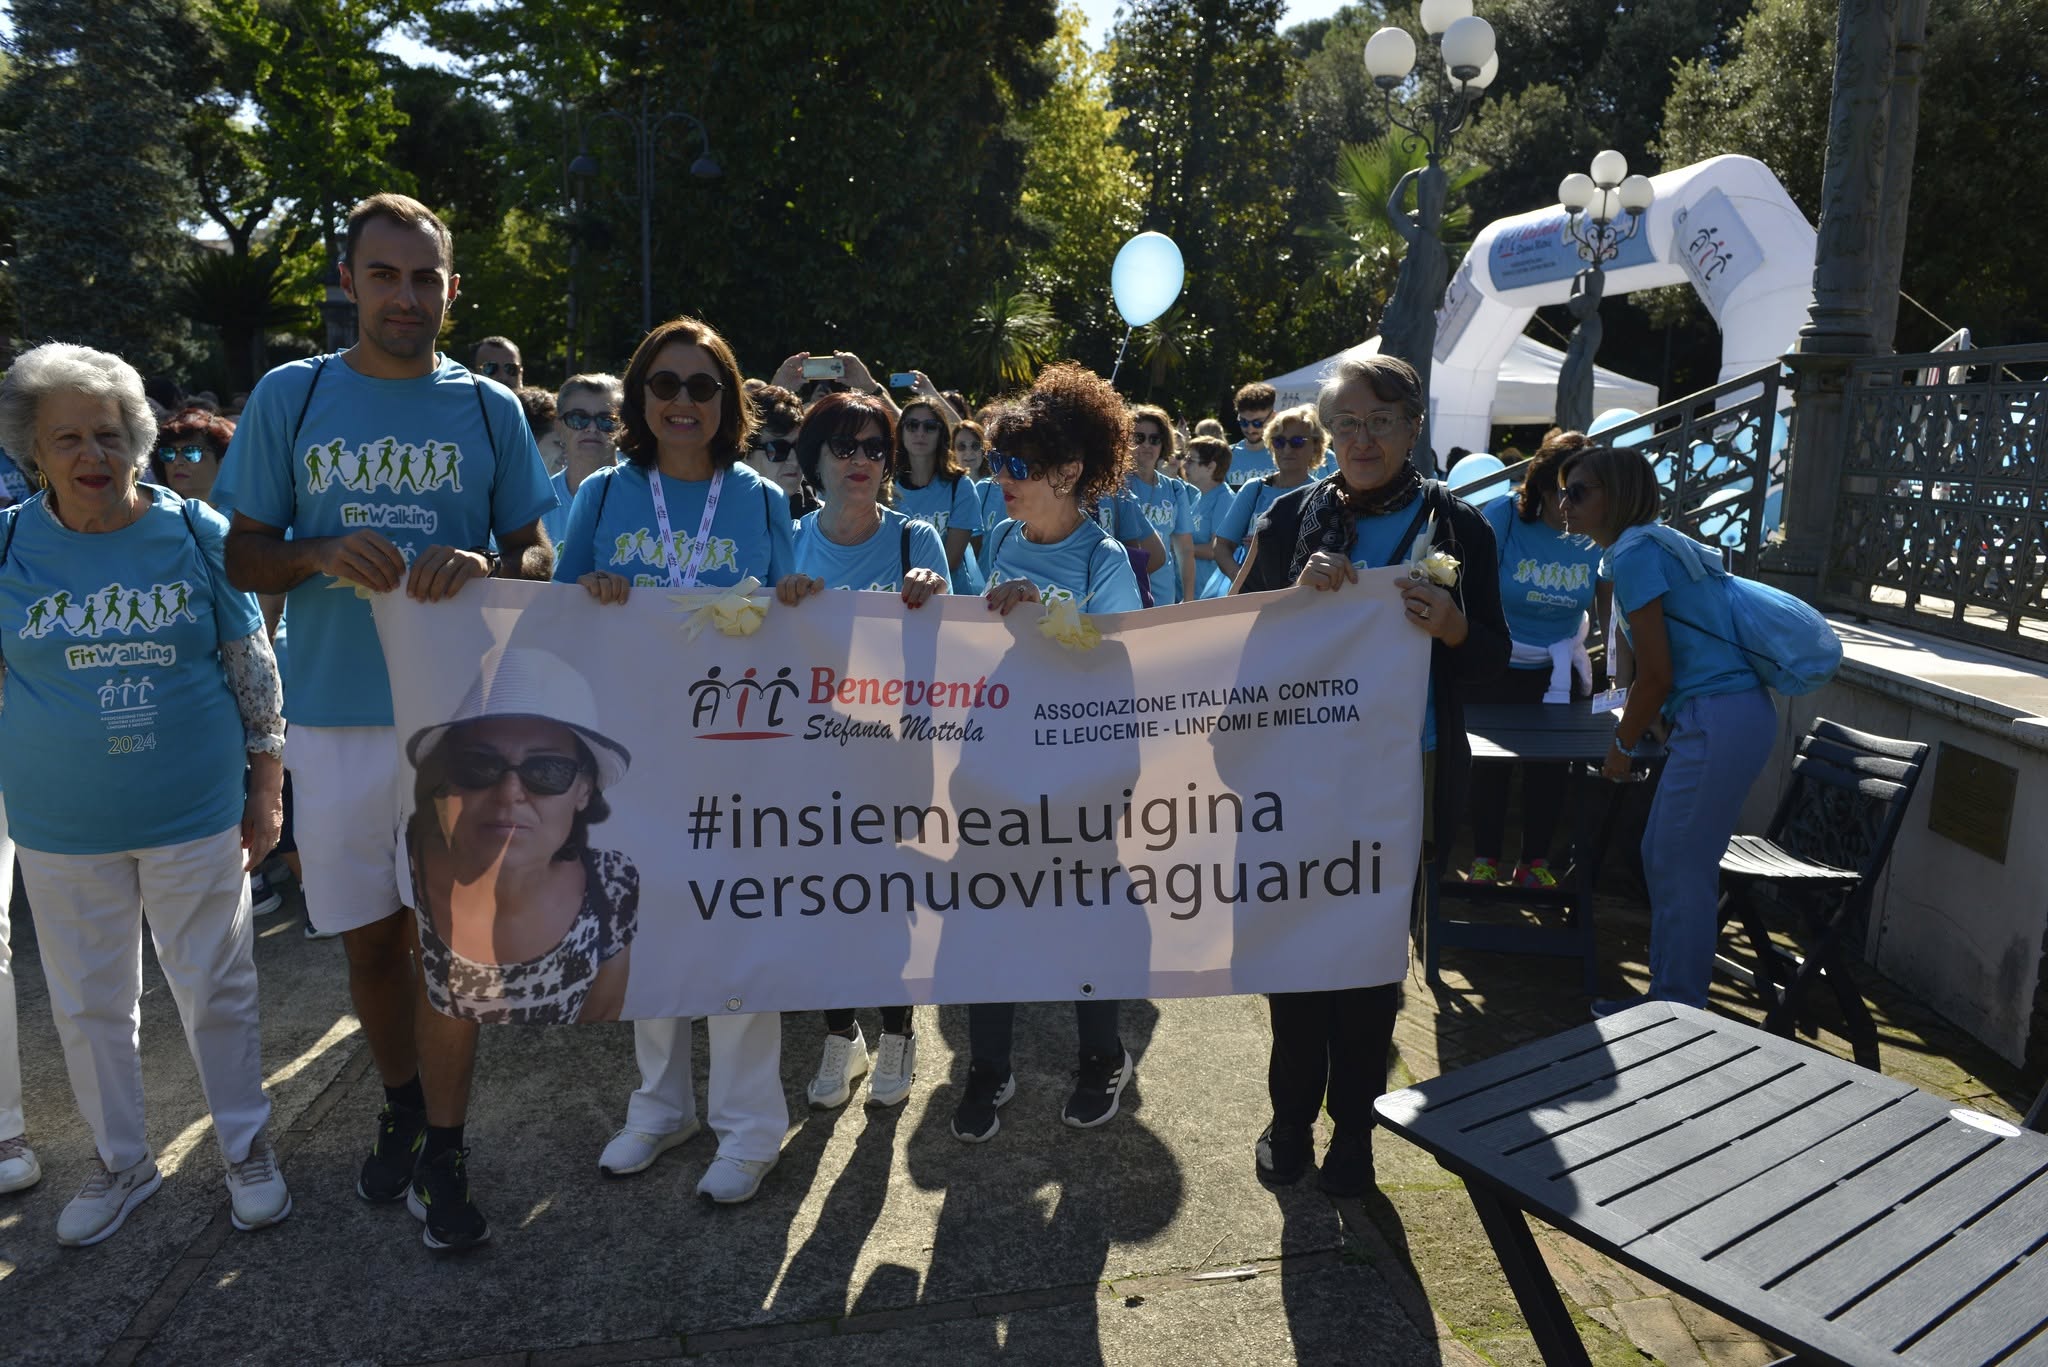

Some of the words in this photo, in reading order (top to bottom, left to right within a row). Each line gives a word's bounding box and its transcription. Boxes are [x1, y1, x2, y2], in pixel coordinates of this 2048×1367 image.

[343, 504, 436, 532] FitWalking
[67, 643, 174, 668] FitWalking
[808, 667, 1010, 709] Benevento
[1034, 694, 1176, 721] ASSOCIAZIONE
[1182, 685, 1268, 708] ITALIANA
[1278, 678, 1359, 700] CONTRO
[108, 733, 156, 754] 2024
[803, 714, 894, 746] Stefania
[899, 714, 985, 742] Mottola
[1035, 729, 1057, 745] LE
[1063, 720, 1159, 745] LEUCEMIE
[1175, 713, 1251, 735] LINFOMI
[1258, 711, 1268, 728] E
[1273, 704, 1360, 726] MIELOMA
[688, 782, 1285, 852] #insiemeaLuigina
[689, 840, 1383, 921] versonuovitraguardi
